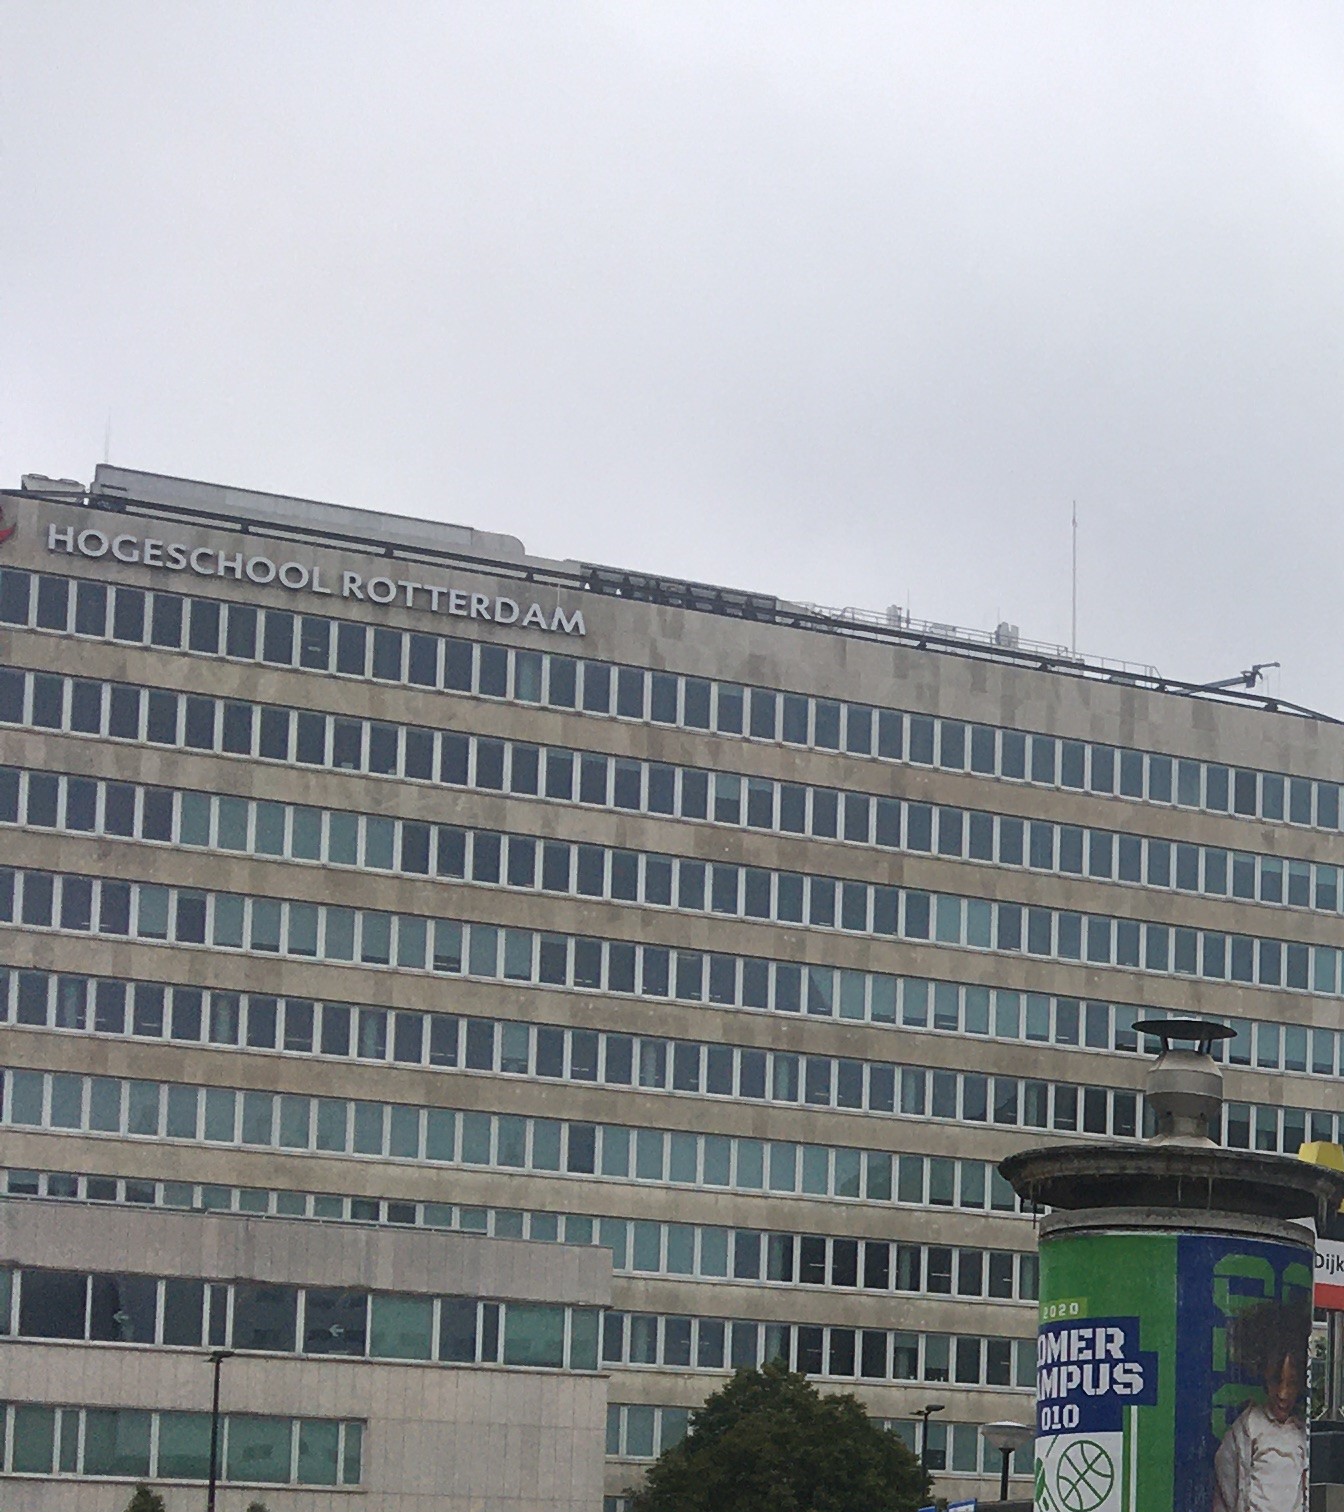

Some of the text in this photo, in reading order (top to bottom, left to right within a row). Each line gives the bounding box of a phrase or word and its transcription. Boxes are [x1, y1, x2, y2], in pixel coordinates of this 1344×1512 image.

[47, 523, 587, 637] HOGESCHOOL ROTTERDAM
[1043, 1302, 1079, 1319] 2020
[1041, 1404, 1080, 1431] 010
